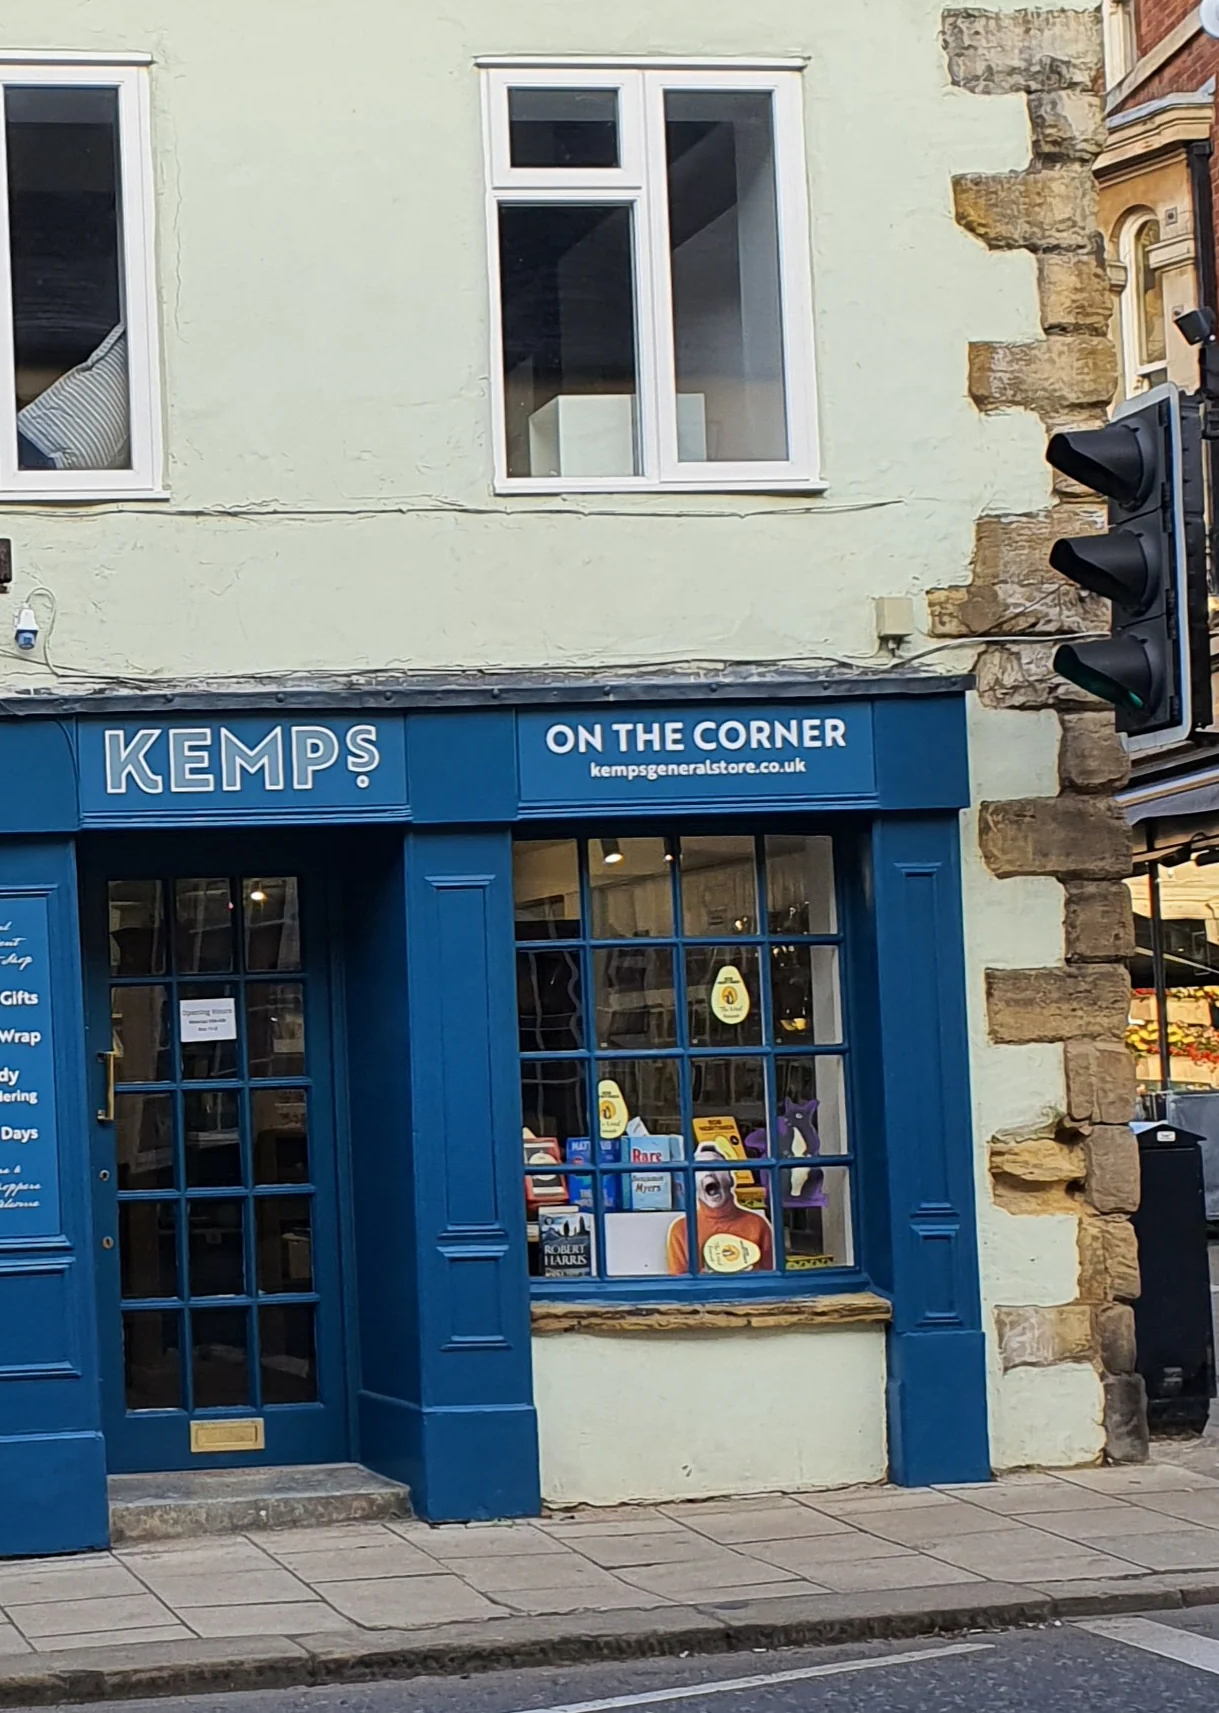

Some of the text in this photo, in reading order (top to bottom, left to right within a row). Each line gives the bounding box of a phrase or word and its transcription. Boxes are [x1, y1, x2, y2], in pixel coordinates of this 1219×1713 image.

[546, 718, 847, 754] ON THE CORNER
[104, 724, 380, 794] KEMPS
[589, 757, 807, 781] kempsgeneralstore.co.uk
[1, 952, 34, 971] Shop
[0, 990, 39, 1006] Gifts
[0, 1126, 39, 1143] Days
[632, 1148, 662, 1164] Rare
[635, 1183, 661, 1193] Myers
[544, 1244, 585, 1255] ROBERT
[544, 1255, 588, 1266] HARRIS
